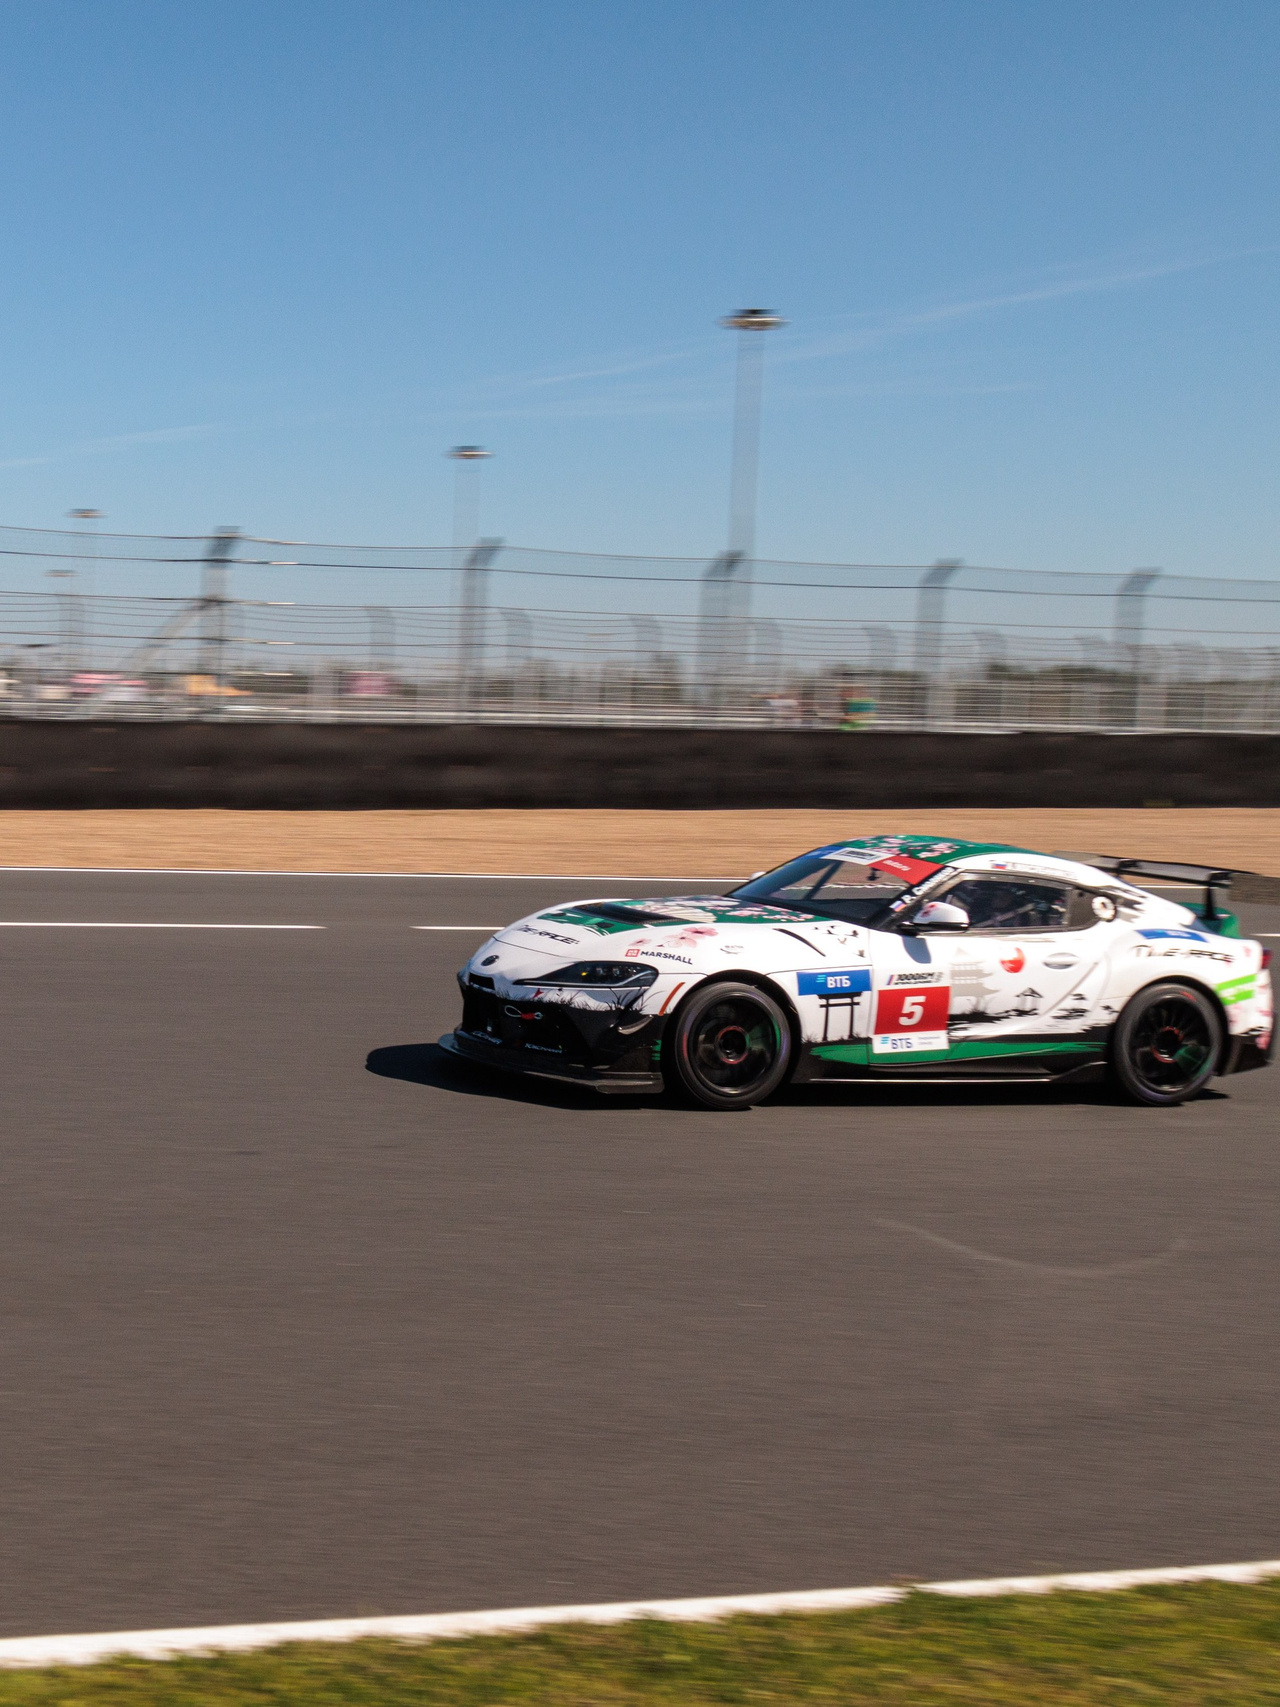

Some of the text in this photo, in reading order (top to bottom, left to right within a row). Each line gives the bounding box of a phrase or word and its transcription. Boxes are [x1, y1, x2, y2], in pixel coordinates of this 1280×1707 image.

[640, 950, 693, 965] MARSHALL
[826, 976, 852, 989] ВТБ
[898, 995, 927, 1026] 5
[891, 1038, 913, 1050] ВТБ
